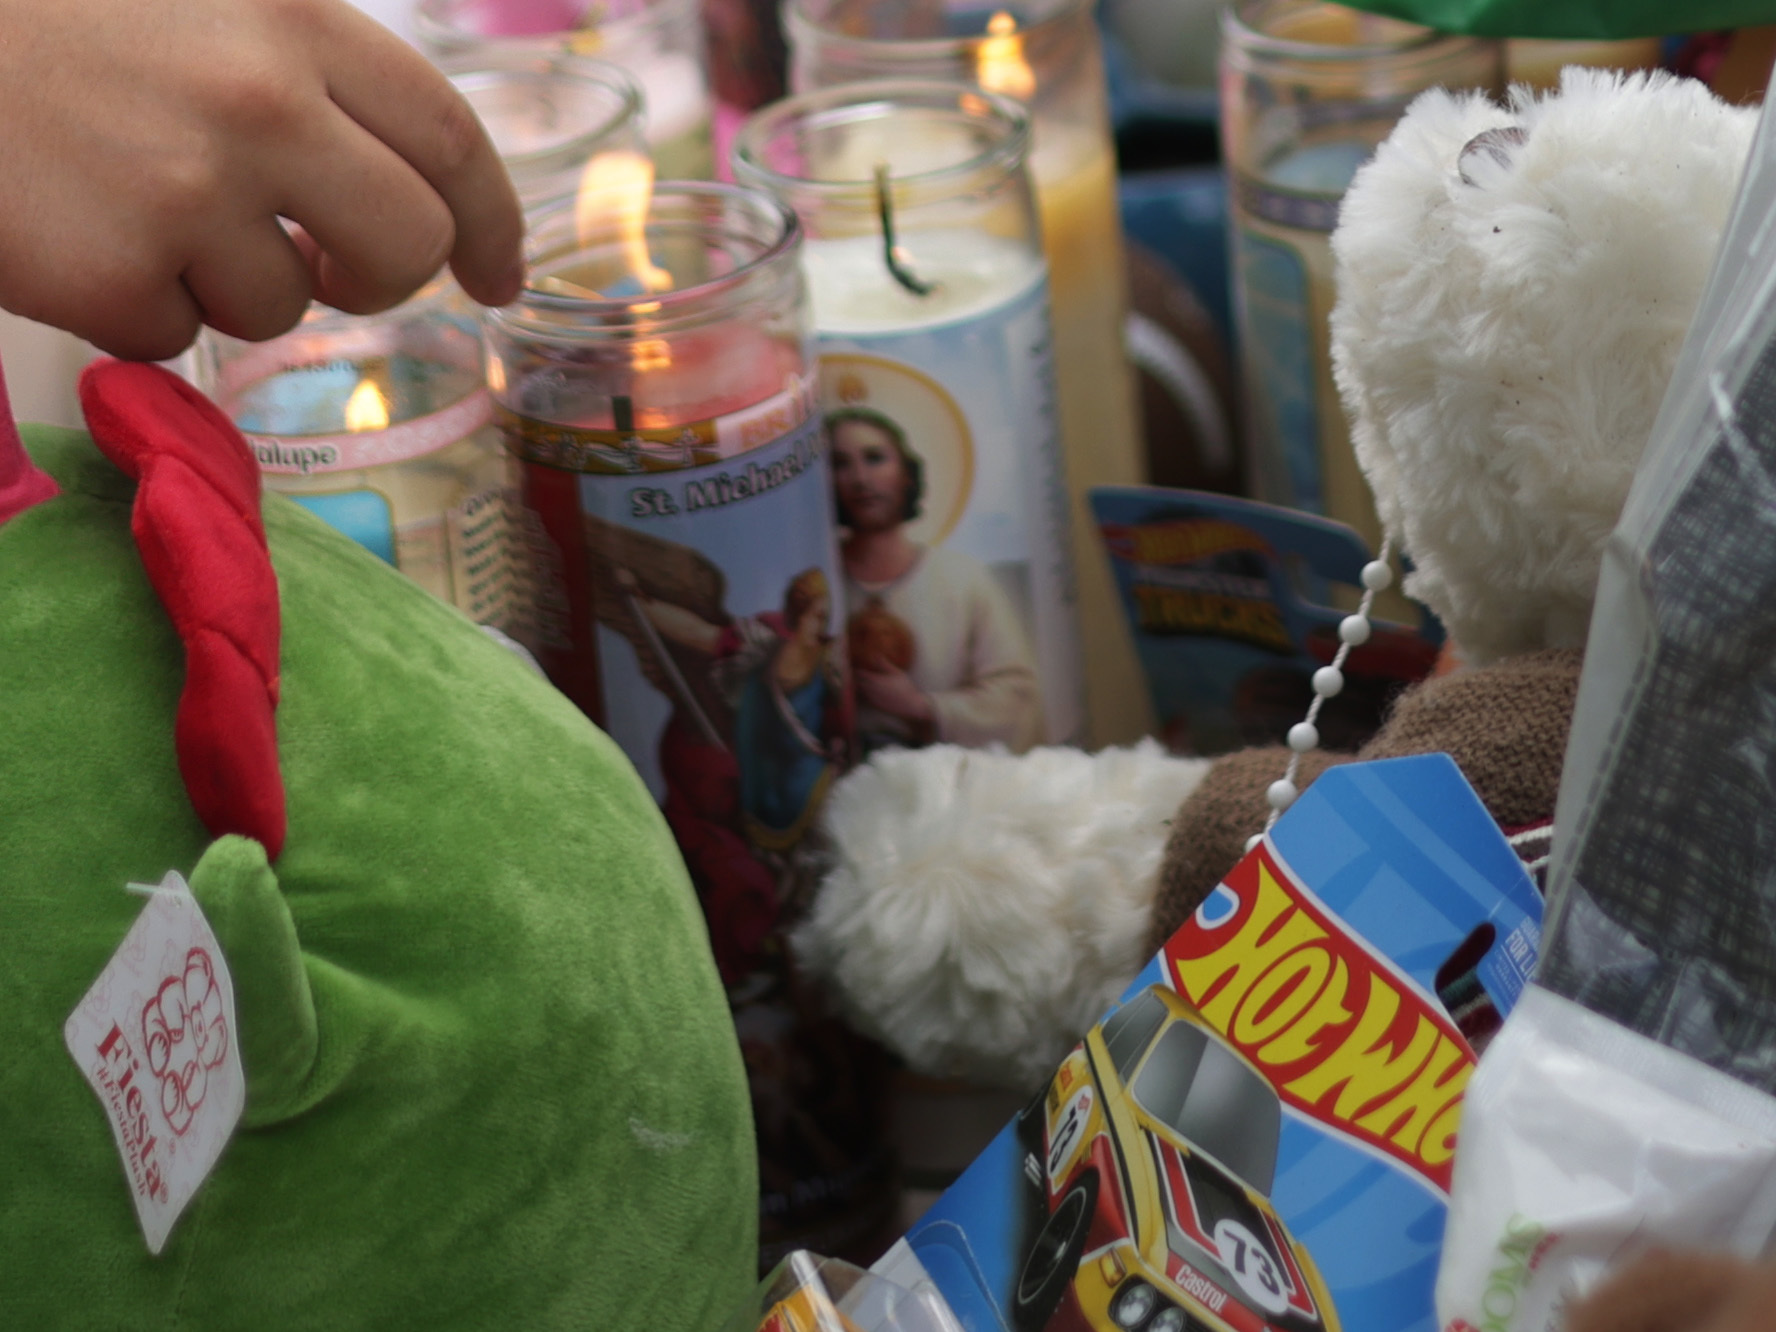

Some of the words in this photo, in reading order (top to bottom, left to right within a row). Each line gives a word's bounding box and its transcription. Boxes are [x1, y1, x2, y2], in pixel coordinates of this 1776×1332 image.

[250, 439, 338, 473] alupe
[631, 486, 680, 519] St.
[685, 439, 804, 512] Michael
[1175, 857, 1354, 1065] HOT
[94, 1018, 161, 1201] Fiesta
[1175, 1250, 1226, 1314] Castrol
[1223, 1221, 1283, 1296] 73
